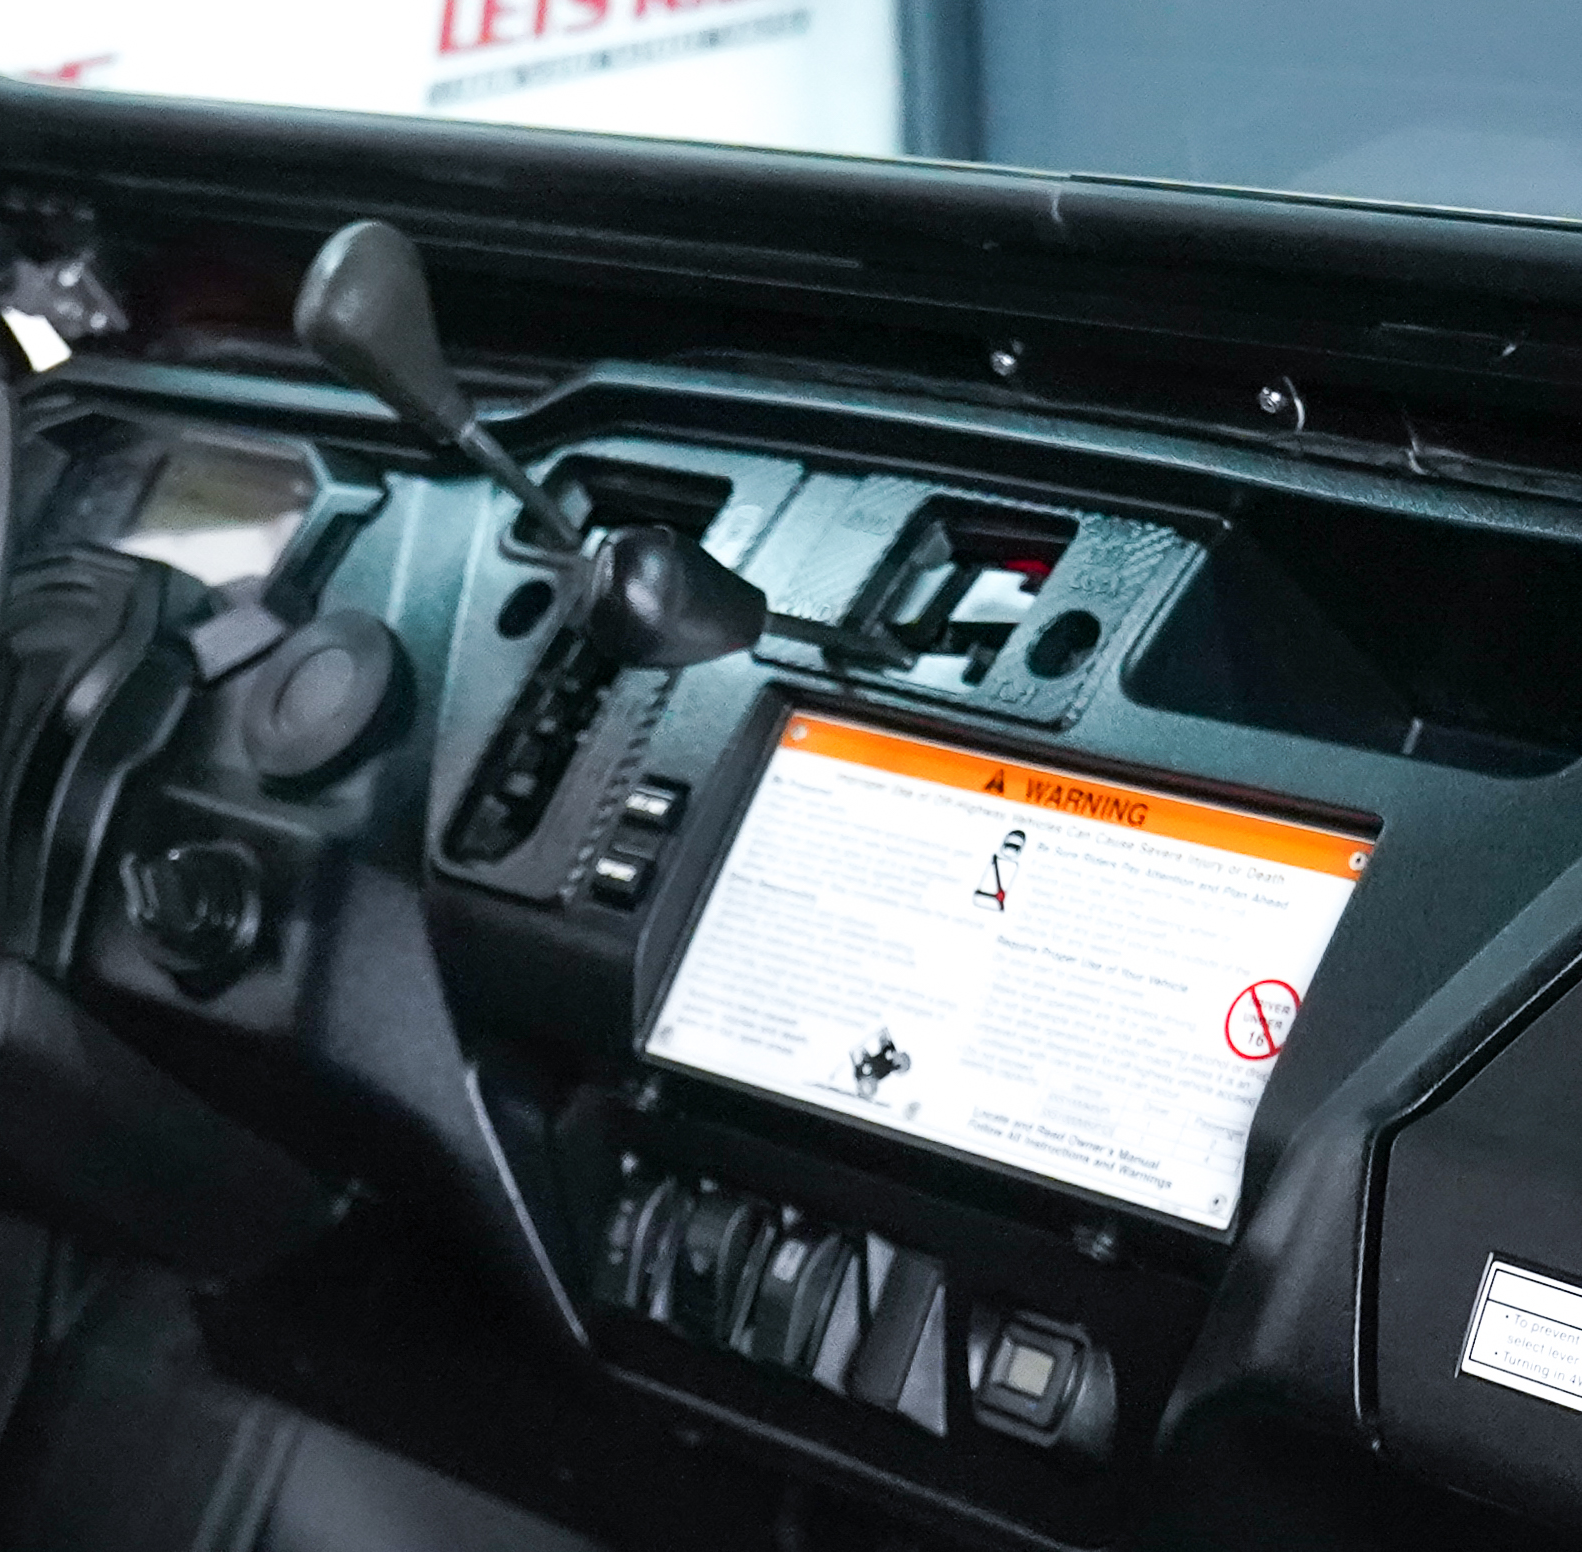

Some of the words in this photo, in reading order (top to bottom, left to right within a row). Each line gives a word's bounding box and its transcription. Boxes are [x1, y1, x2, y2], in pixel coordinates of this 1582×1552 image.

[1024, 779, 1149, 828] WARNING
[1065, 824, 1091, 840] Can
[1094, 831, 1135, 851] Cause
[1138, 841, 1183, 862] Severe
[1186, 853, 1224, 874] Injury
[1226, 864, 1242, 875] or
[1245, 866, 1285, 884] Death
[1250, 892, 1290, 910] Ahead
[1249, 1032, 1266, 1047] 16
[1514, 1312, 1528, 1328] To
[1529, 1322, 1580, 1345] prevent
[1503, 1349, 1550, 1379] Turning
[1552, 1369, 1566, 1381] in
[1506, 1334, 1545, 1353] select
[1547, 1345, 1580, 1364] lever
